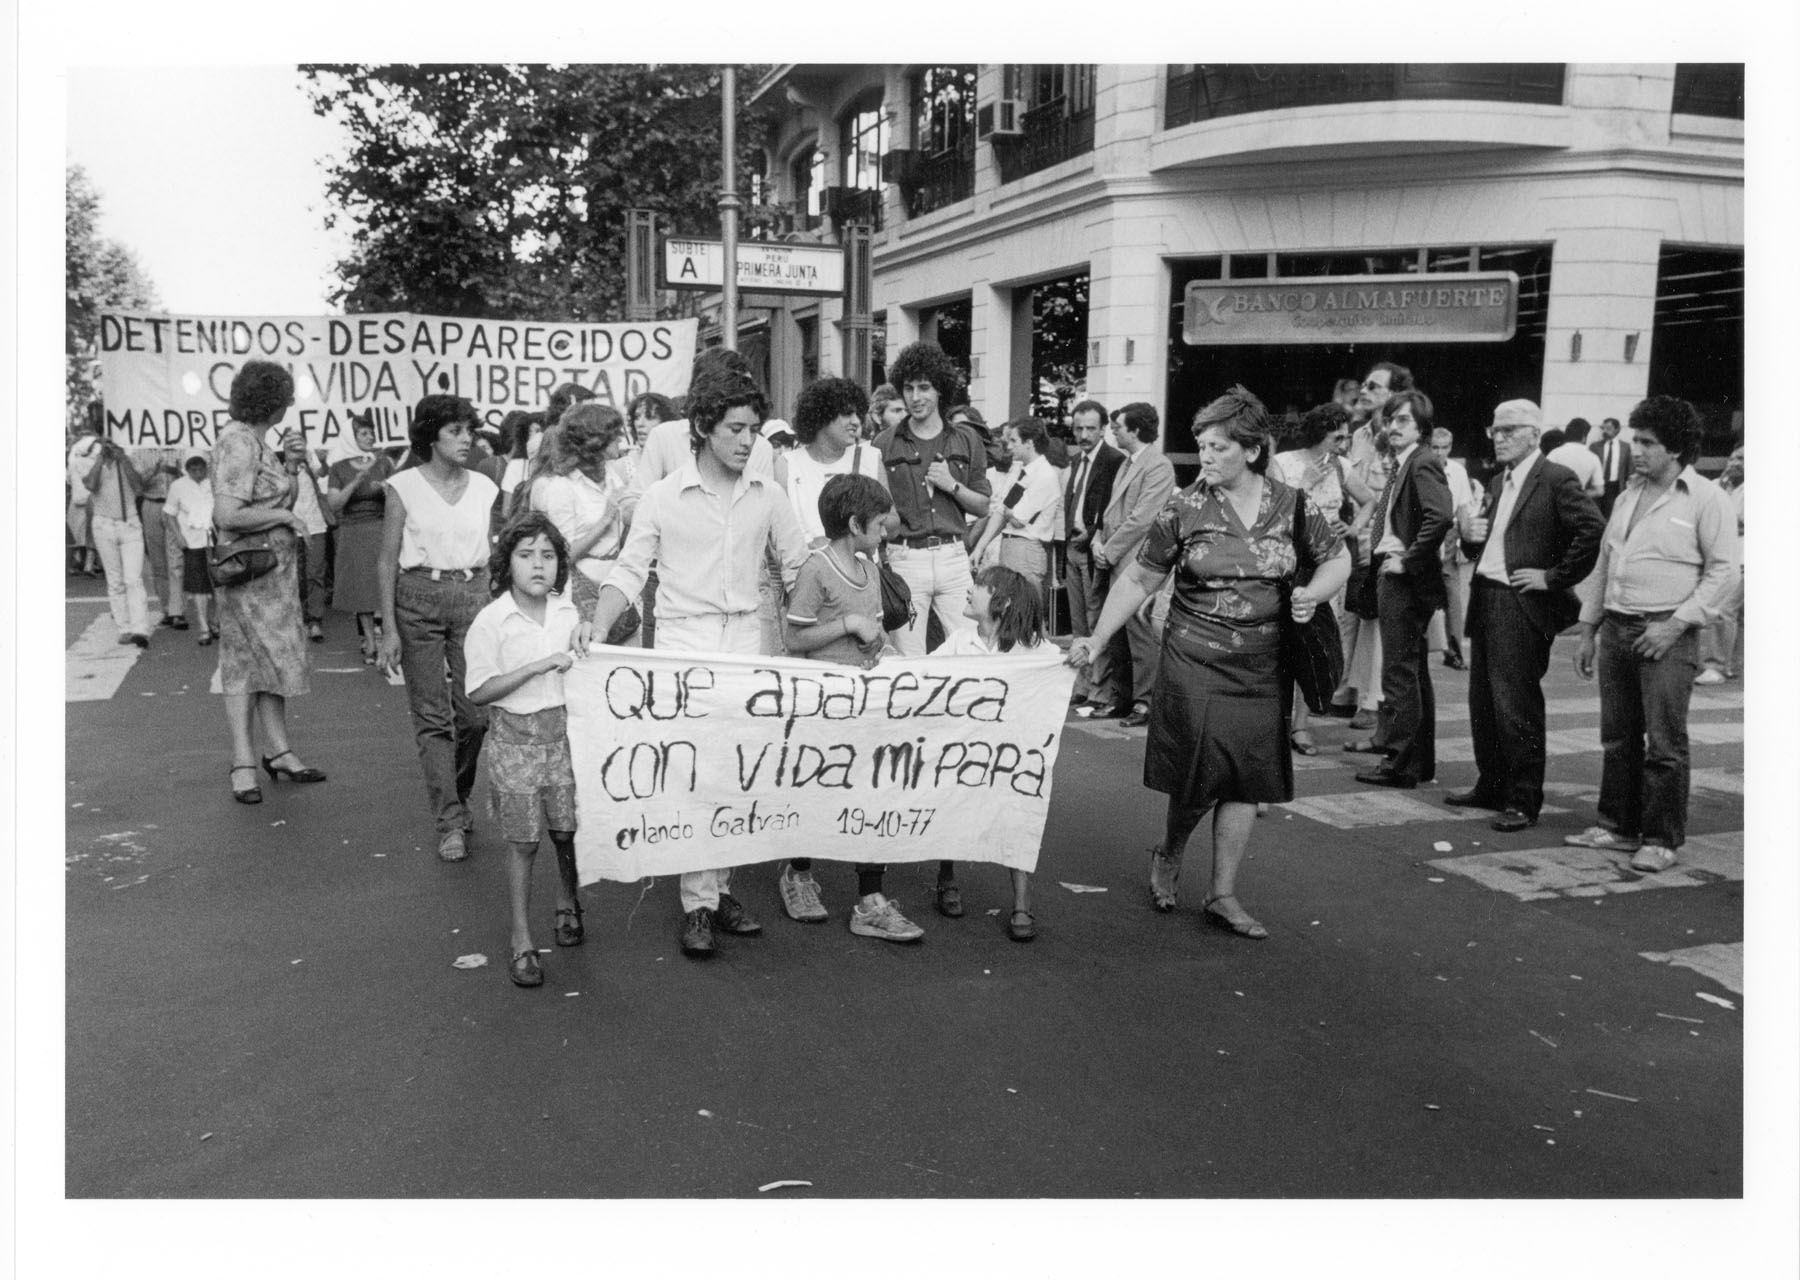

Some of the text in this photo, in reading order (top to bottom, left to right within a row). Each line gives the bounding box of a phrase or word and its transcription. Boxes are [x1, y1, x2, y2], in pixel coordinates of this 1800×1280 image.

[671, 241, 706, 256] SUBTE
[680, 257, 698, 279] A
[737, 261, 818, 279] PRIMERA JUNTA
[1233, 287, 1505, 313] BANCO ALMAFUERTE
[308, 360, 402, 404] VIDA
[411, 359, 440, 398] Y
[106, 408, 232, 447] MADRE
[744, 669, 1009, 739] aparezca
[601, 740, 696, 801] con
[872, 736, 925, 791] mi
[836, 807, 936, 838] 19-10-77
